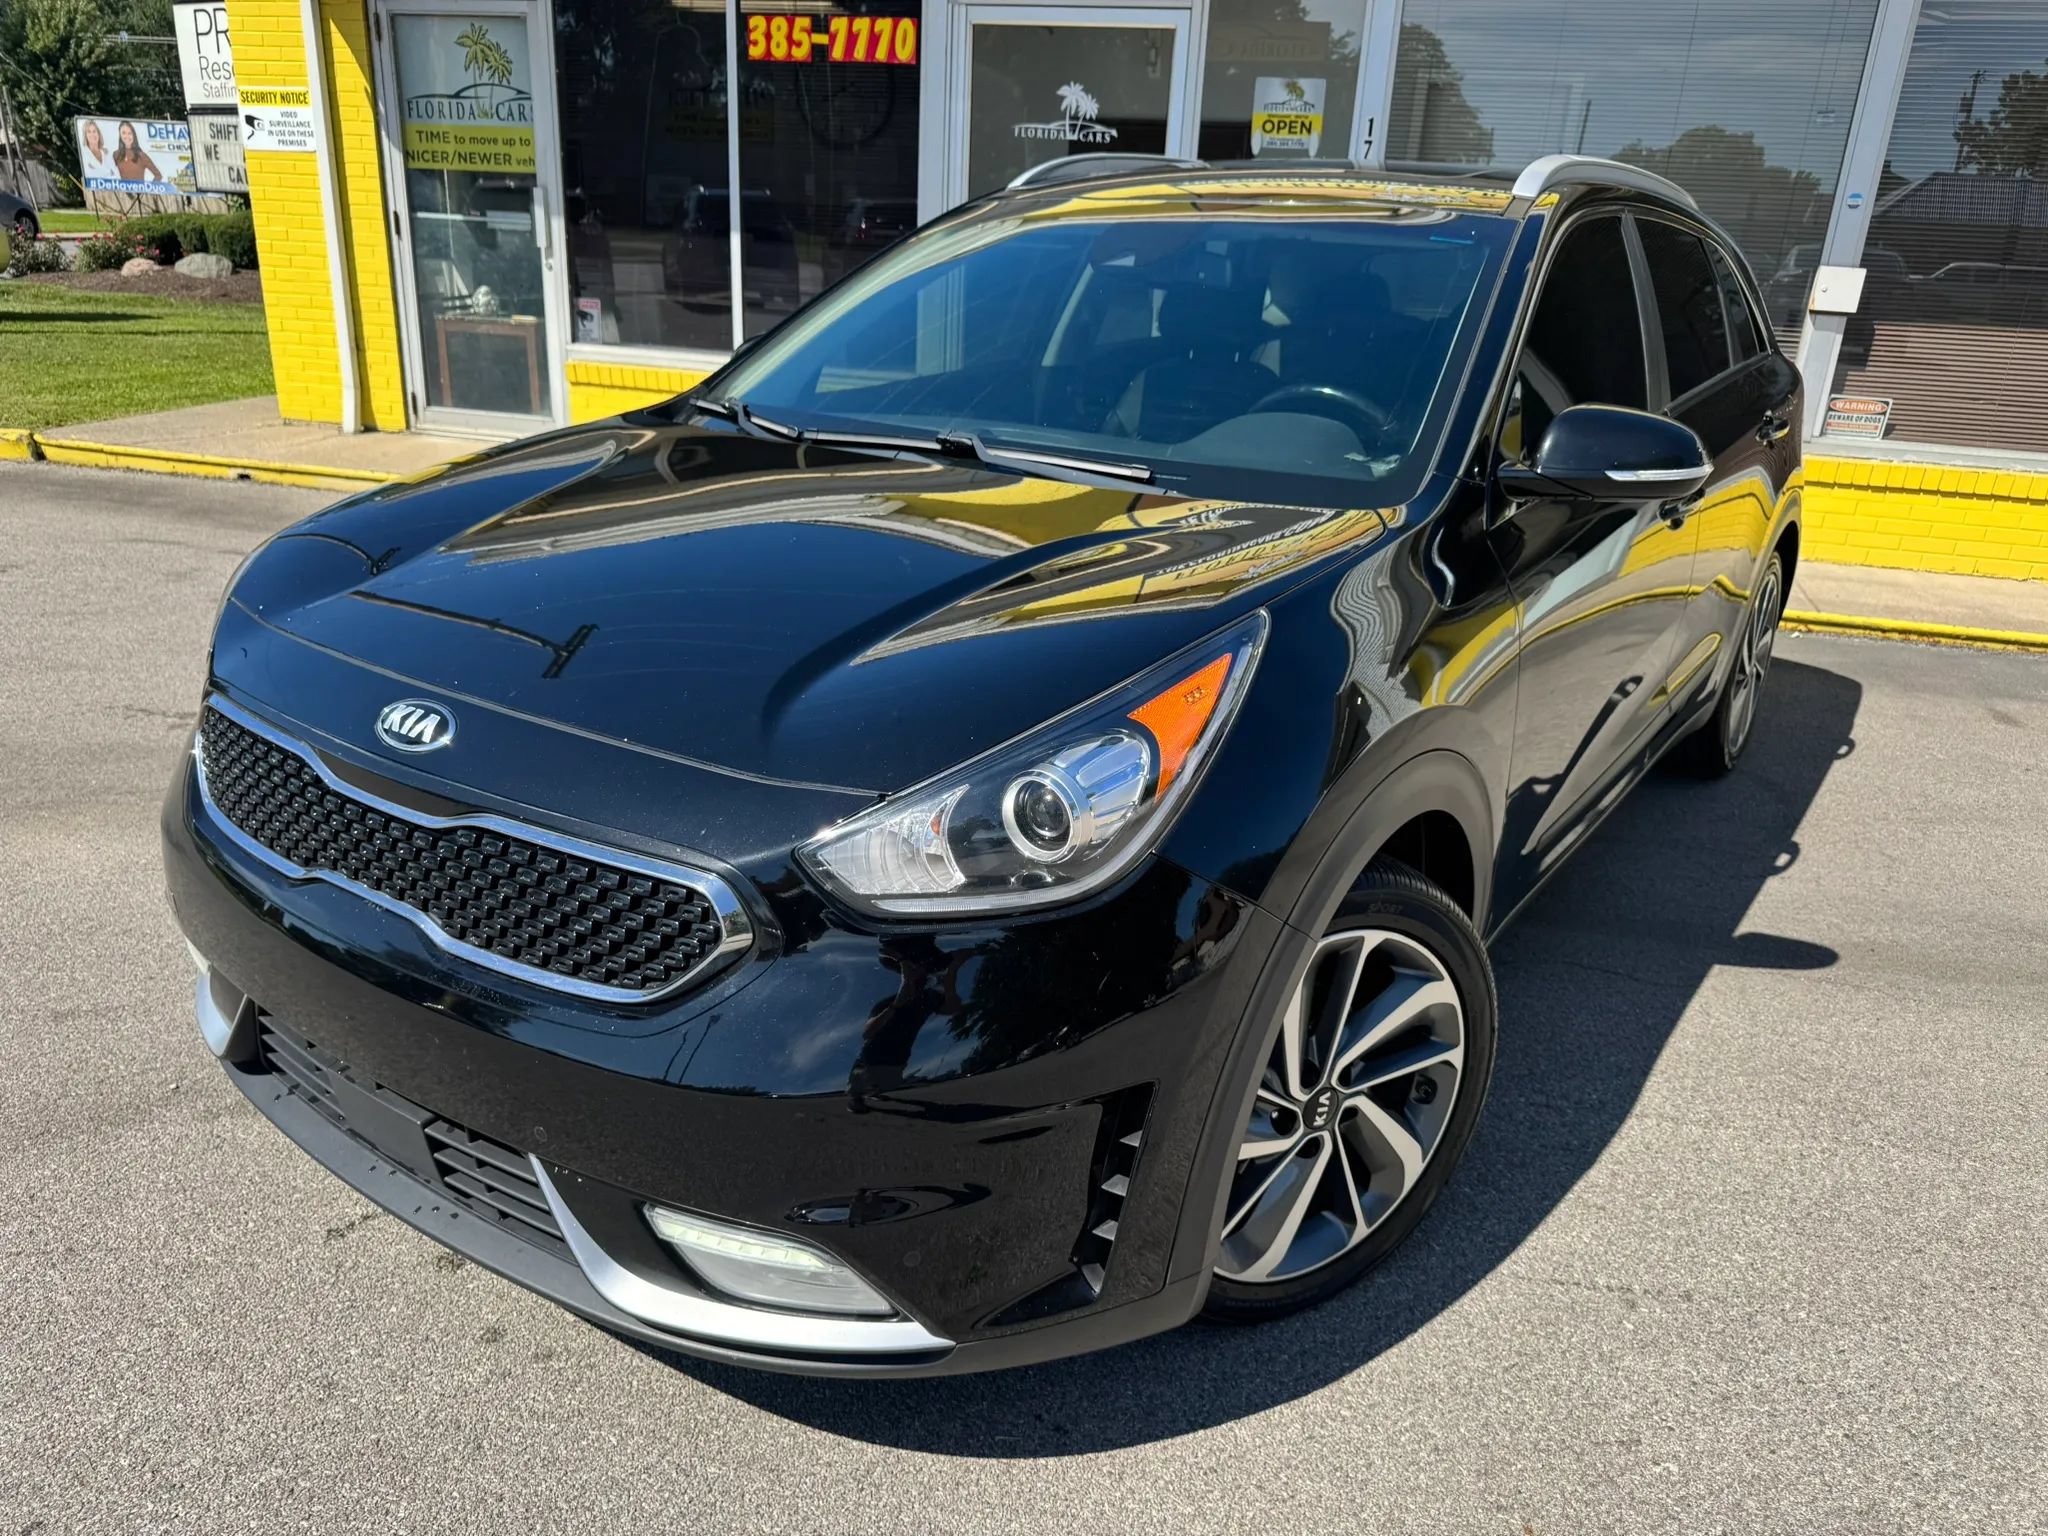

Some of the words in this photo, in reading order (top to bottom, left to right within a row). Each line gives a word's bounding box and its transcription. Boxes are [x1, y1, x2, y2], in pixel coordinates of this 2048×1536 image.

[747, 15, 917, 62] 385-7770
[198, 55, 235, 80] Res
[240, 90, 278, 104] SECURITY
[280, 91, 309, 105] NOTICE
[280, 111, 298, 119] VIDEO
[407, 100, 477, 121] FLORIDA
[495, 101, 533, 122] CAR
[209, 122, 239, 141] SHIFT
[269, 120, 311, 128] SURVEILLANCE
[1262, 119, 1313, 135] OPEN
[287, 130, 296, 138] ON
[297, 130, 314, 138] THESE
[416, 130, 452, 144] TIME
[454, 134, 466, 145] to
[468, 136, 499, 146] move
[502, 137, 516, 147] up
[519, 136, 531, 146] to
[1014, 127, 1066, 140] FLORIDA
[1080, 130, 1112, 144] CARS
[278, 139, 307, 147] PREMISES
[203, 143, 220, 161] WE
[406, 149, 512, 167] NICER/NEWER
[90, 179, 166, 194] #DeHavenDuo
[1836, 401, 1882, 412] WARNING
[1828, 413, 1854, 422] BEWARE
[1855, 415, 1864, 423] OF
[1864, 416, 1882, 425] DOGS
[383, 704, 441, 744] KIA
[1313, 1091, 1332, 1127] KIA
